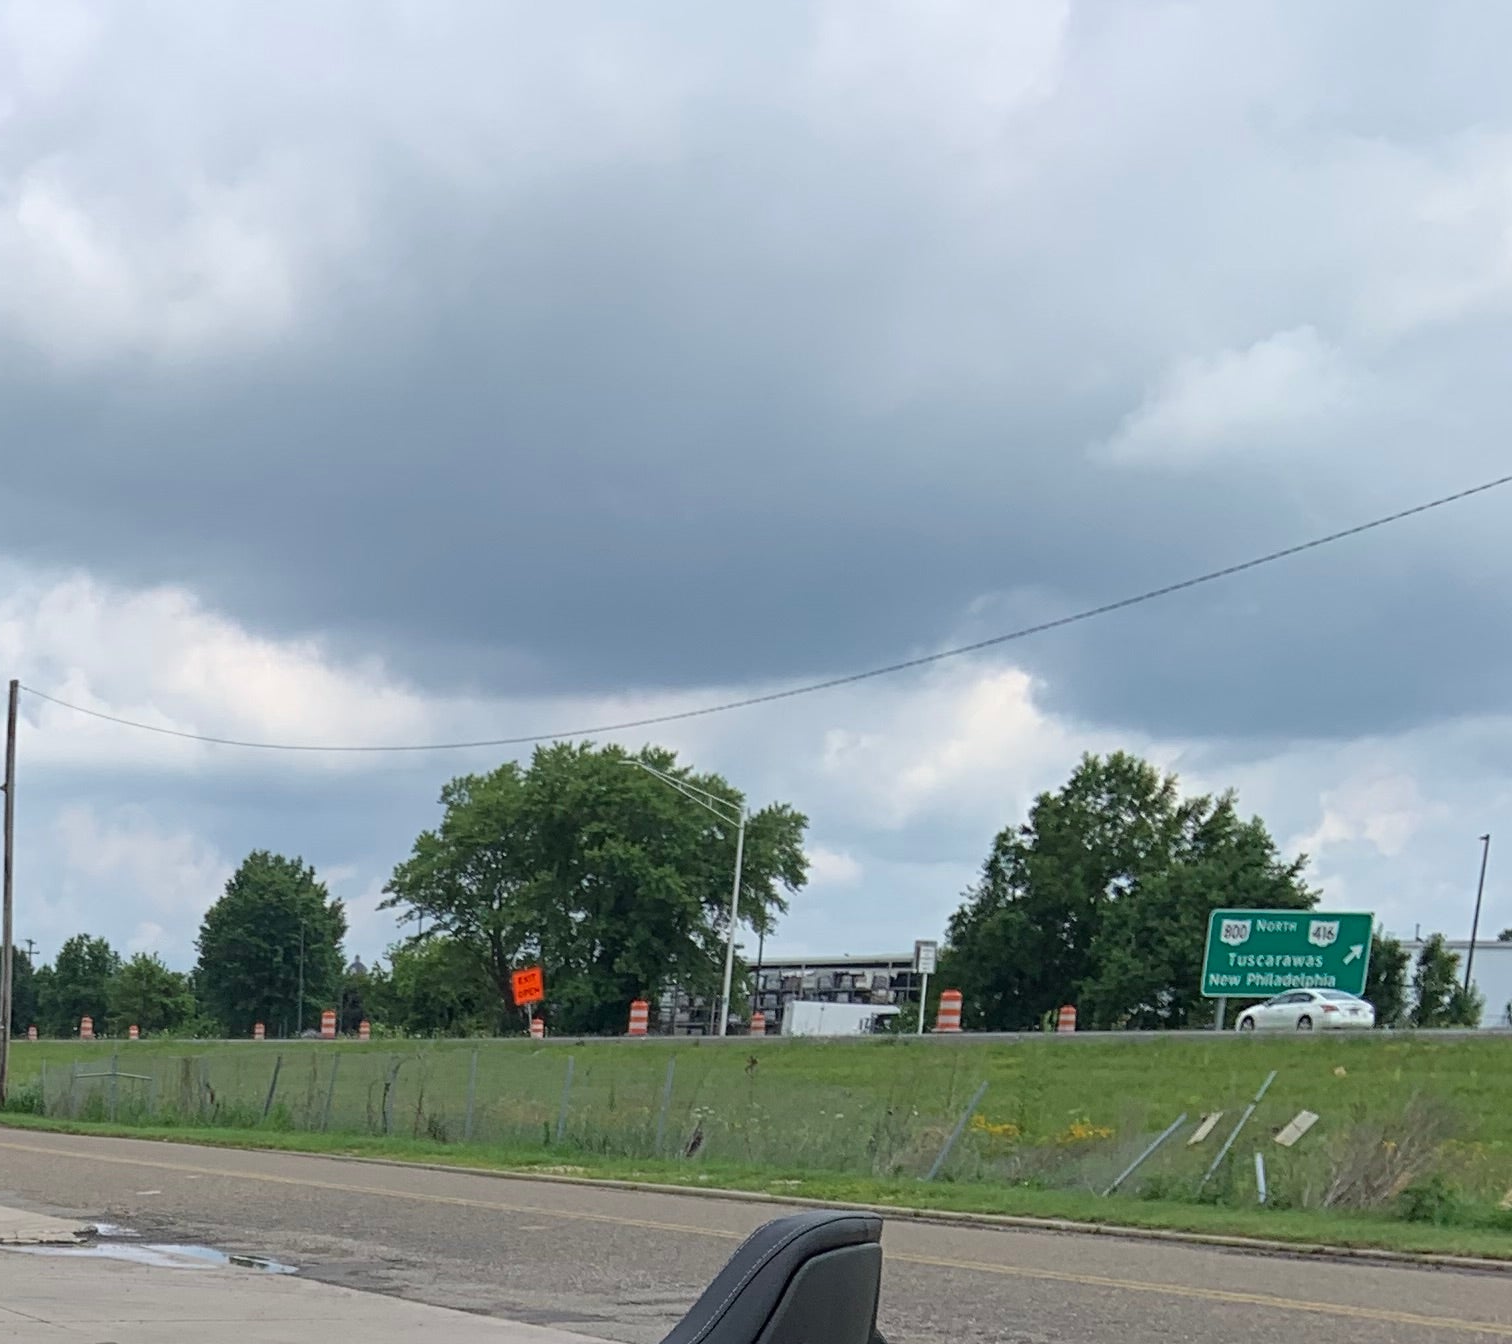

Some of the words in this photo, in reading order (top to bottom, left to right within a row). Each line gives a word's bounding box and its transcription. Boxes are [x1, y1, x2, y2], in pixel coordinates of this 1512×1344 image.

[1223, 924, 1248, 939] 800
[1256, 919, 1297, 933] NORTH
[1312, 927, 1335, 940] 416
[1228, 952, 1324, 968] Tuscarawas
[1209, 972, 1242, 987] New
[1247, 972, 1336, 988] Philadelphia
